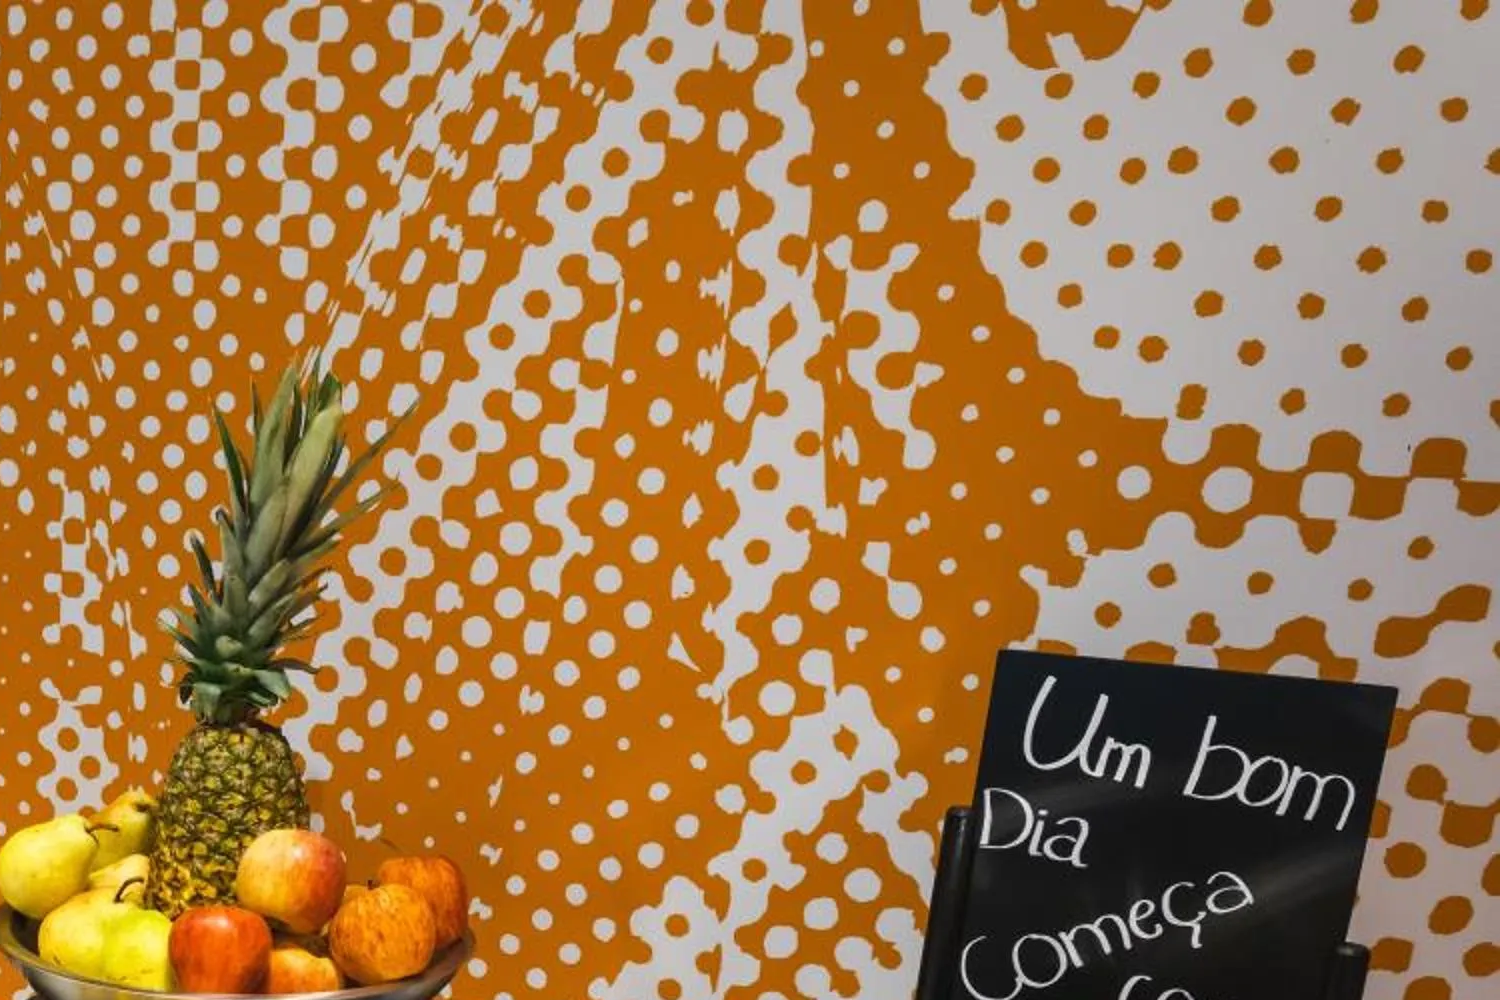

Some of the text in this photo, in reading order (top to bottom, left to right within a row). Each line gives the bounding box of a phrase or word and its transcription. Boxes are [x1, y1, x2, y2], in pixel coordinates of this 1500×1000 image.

[1023, 675, 1356, 831] Um bom
[979, 787, 1089, 868] Dia
